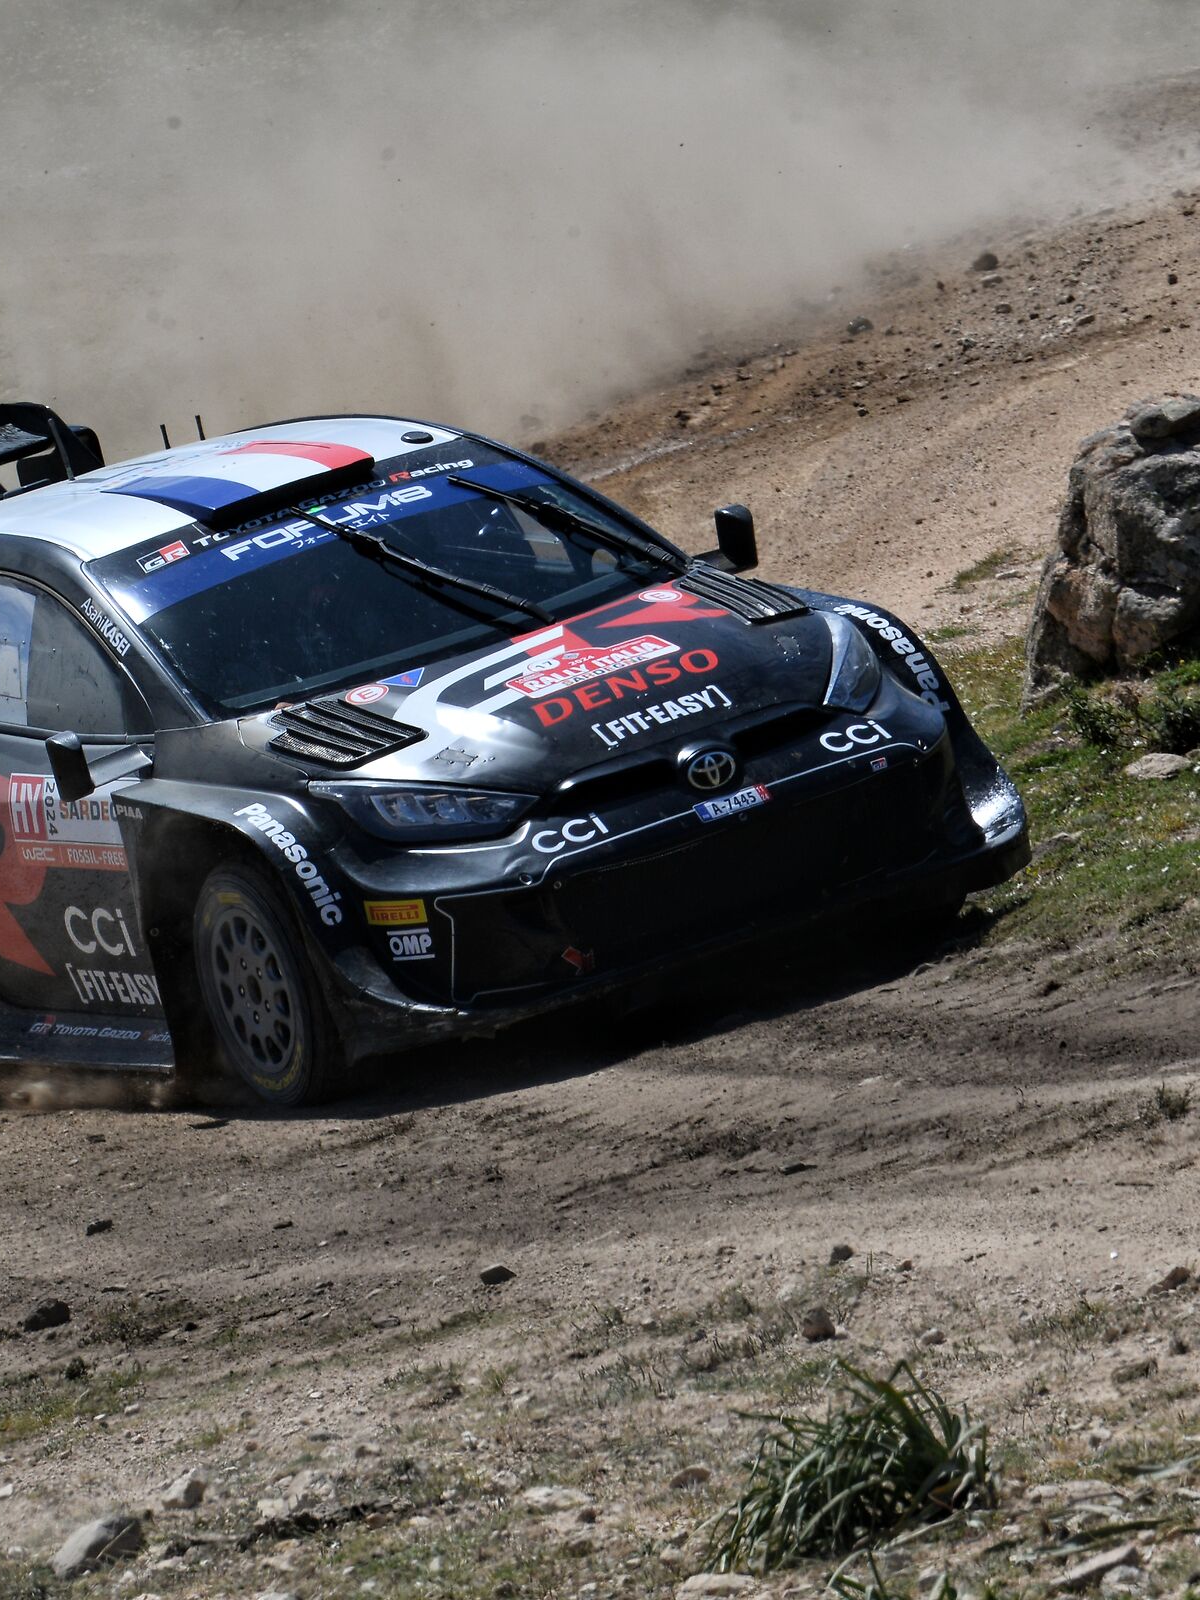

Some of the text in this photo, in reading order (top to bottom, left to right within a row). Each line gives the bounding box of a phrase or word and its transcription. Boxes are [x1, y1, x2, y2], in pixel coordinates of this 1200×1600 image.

[389, 459, 474, 483] Racing
[523, 664, 590, 692] RALLY
[595, 641, 665, 668] ITALIA
[833, 604, 950, 713] Panasonic
[529, 649, 719, 728] DENSO
[11, 782, 42, 834] HY
[44, 781, 58, 836] 2024
[116, 804, 143, 820] PIAA
[711, 791, 757, 816] A-7445
[233, 802, 343, 927] Panasonic
[369, 904, 419, 922] PIRELLI
[389, 933, 433, 955] OMP
